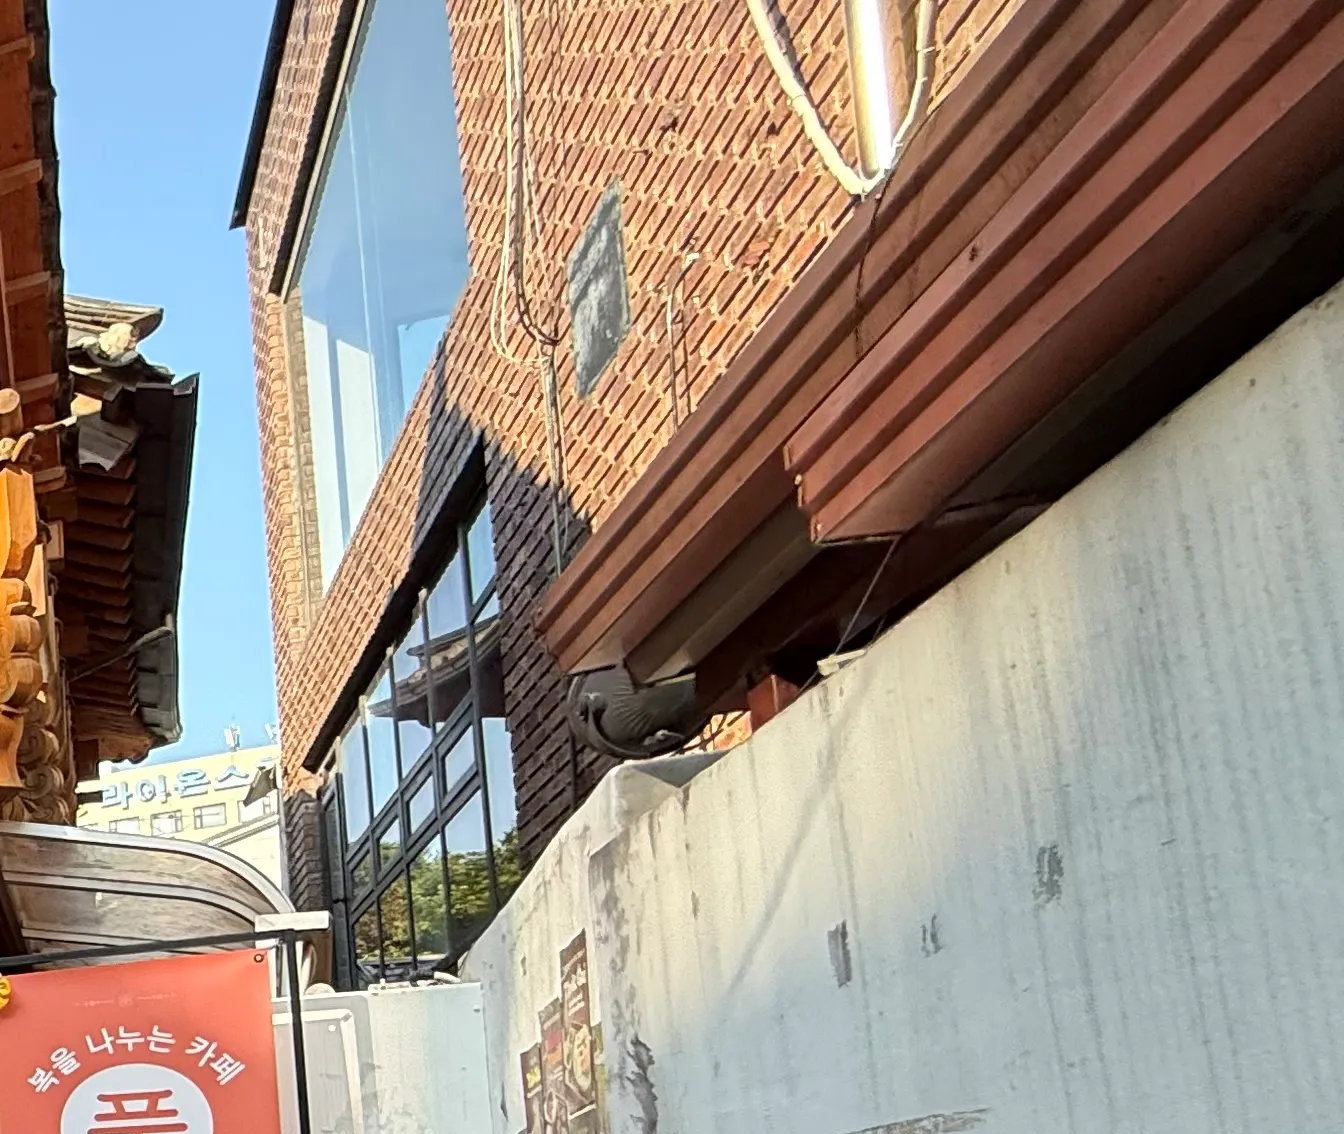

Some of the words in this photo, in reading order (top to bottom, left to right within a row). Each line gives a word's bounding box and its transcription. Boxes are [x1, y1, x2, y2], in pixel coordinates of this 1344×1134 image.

[100, 757, 280, 810] 라이온스
[26, 1045, 82, 1094] 복을
[85, 1024, 177, 1057] 나누는
[184, 1034, 246, 1087] 카페
